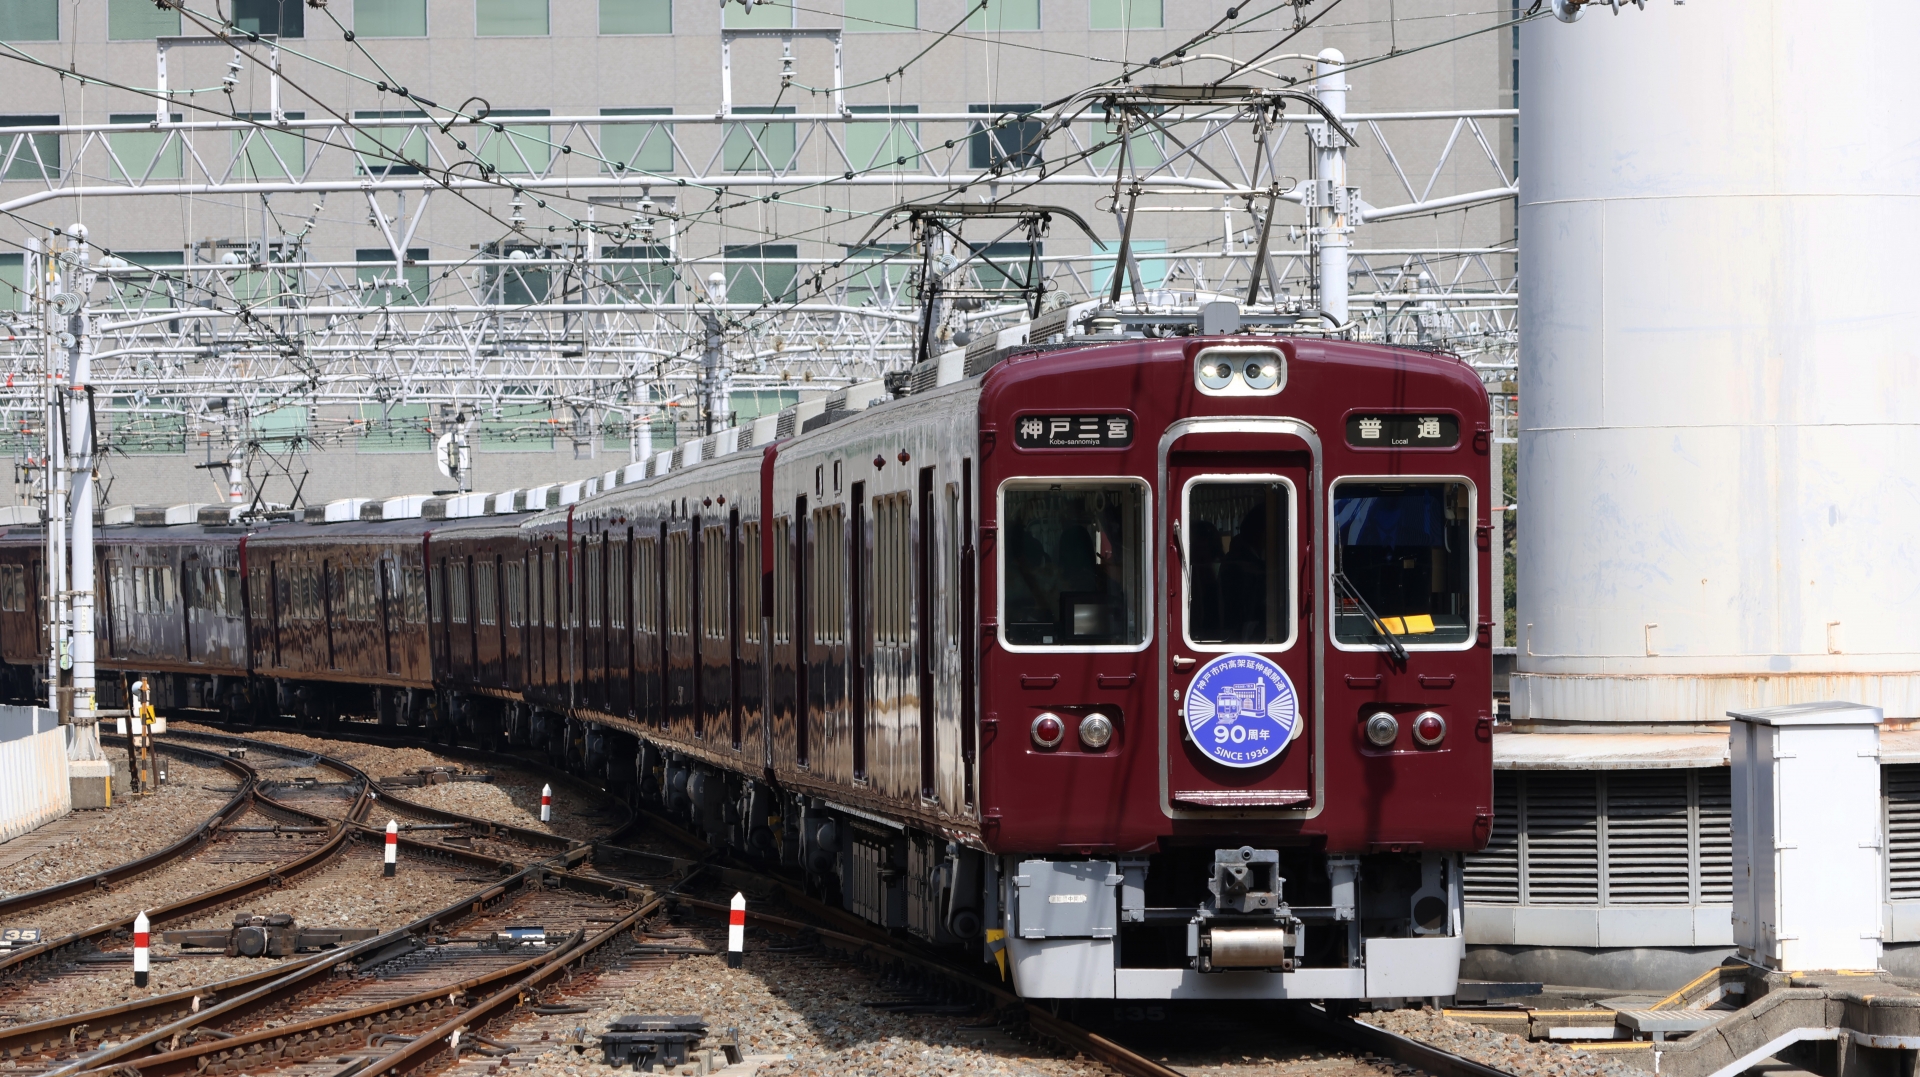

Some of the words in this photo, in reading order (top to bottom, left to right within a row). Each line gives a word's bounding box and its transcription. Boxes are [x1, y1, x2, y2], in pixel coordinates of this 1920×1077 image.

[1020, 417, 1129, 439] 神戸三宮
[1358, 417, 1441, 439] 普通
[1197, 659, 1287, 692] 神戸市内高架延伸線開通
[1214, 746, 1243, 760] SINCE
[1246, 746, 1269, 760] 1936
[4, 929, 37, 940] 35
